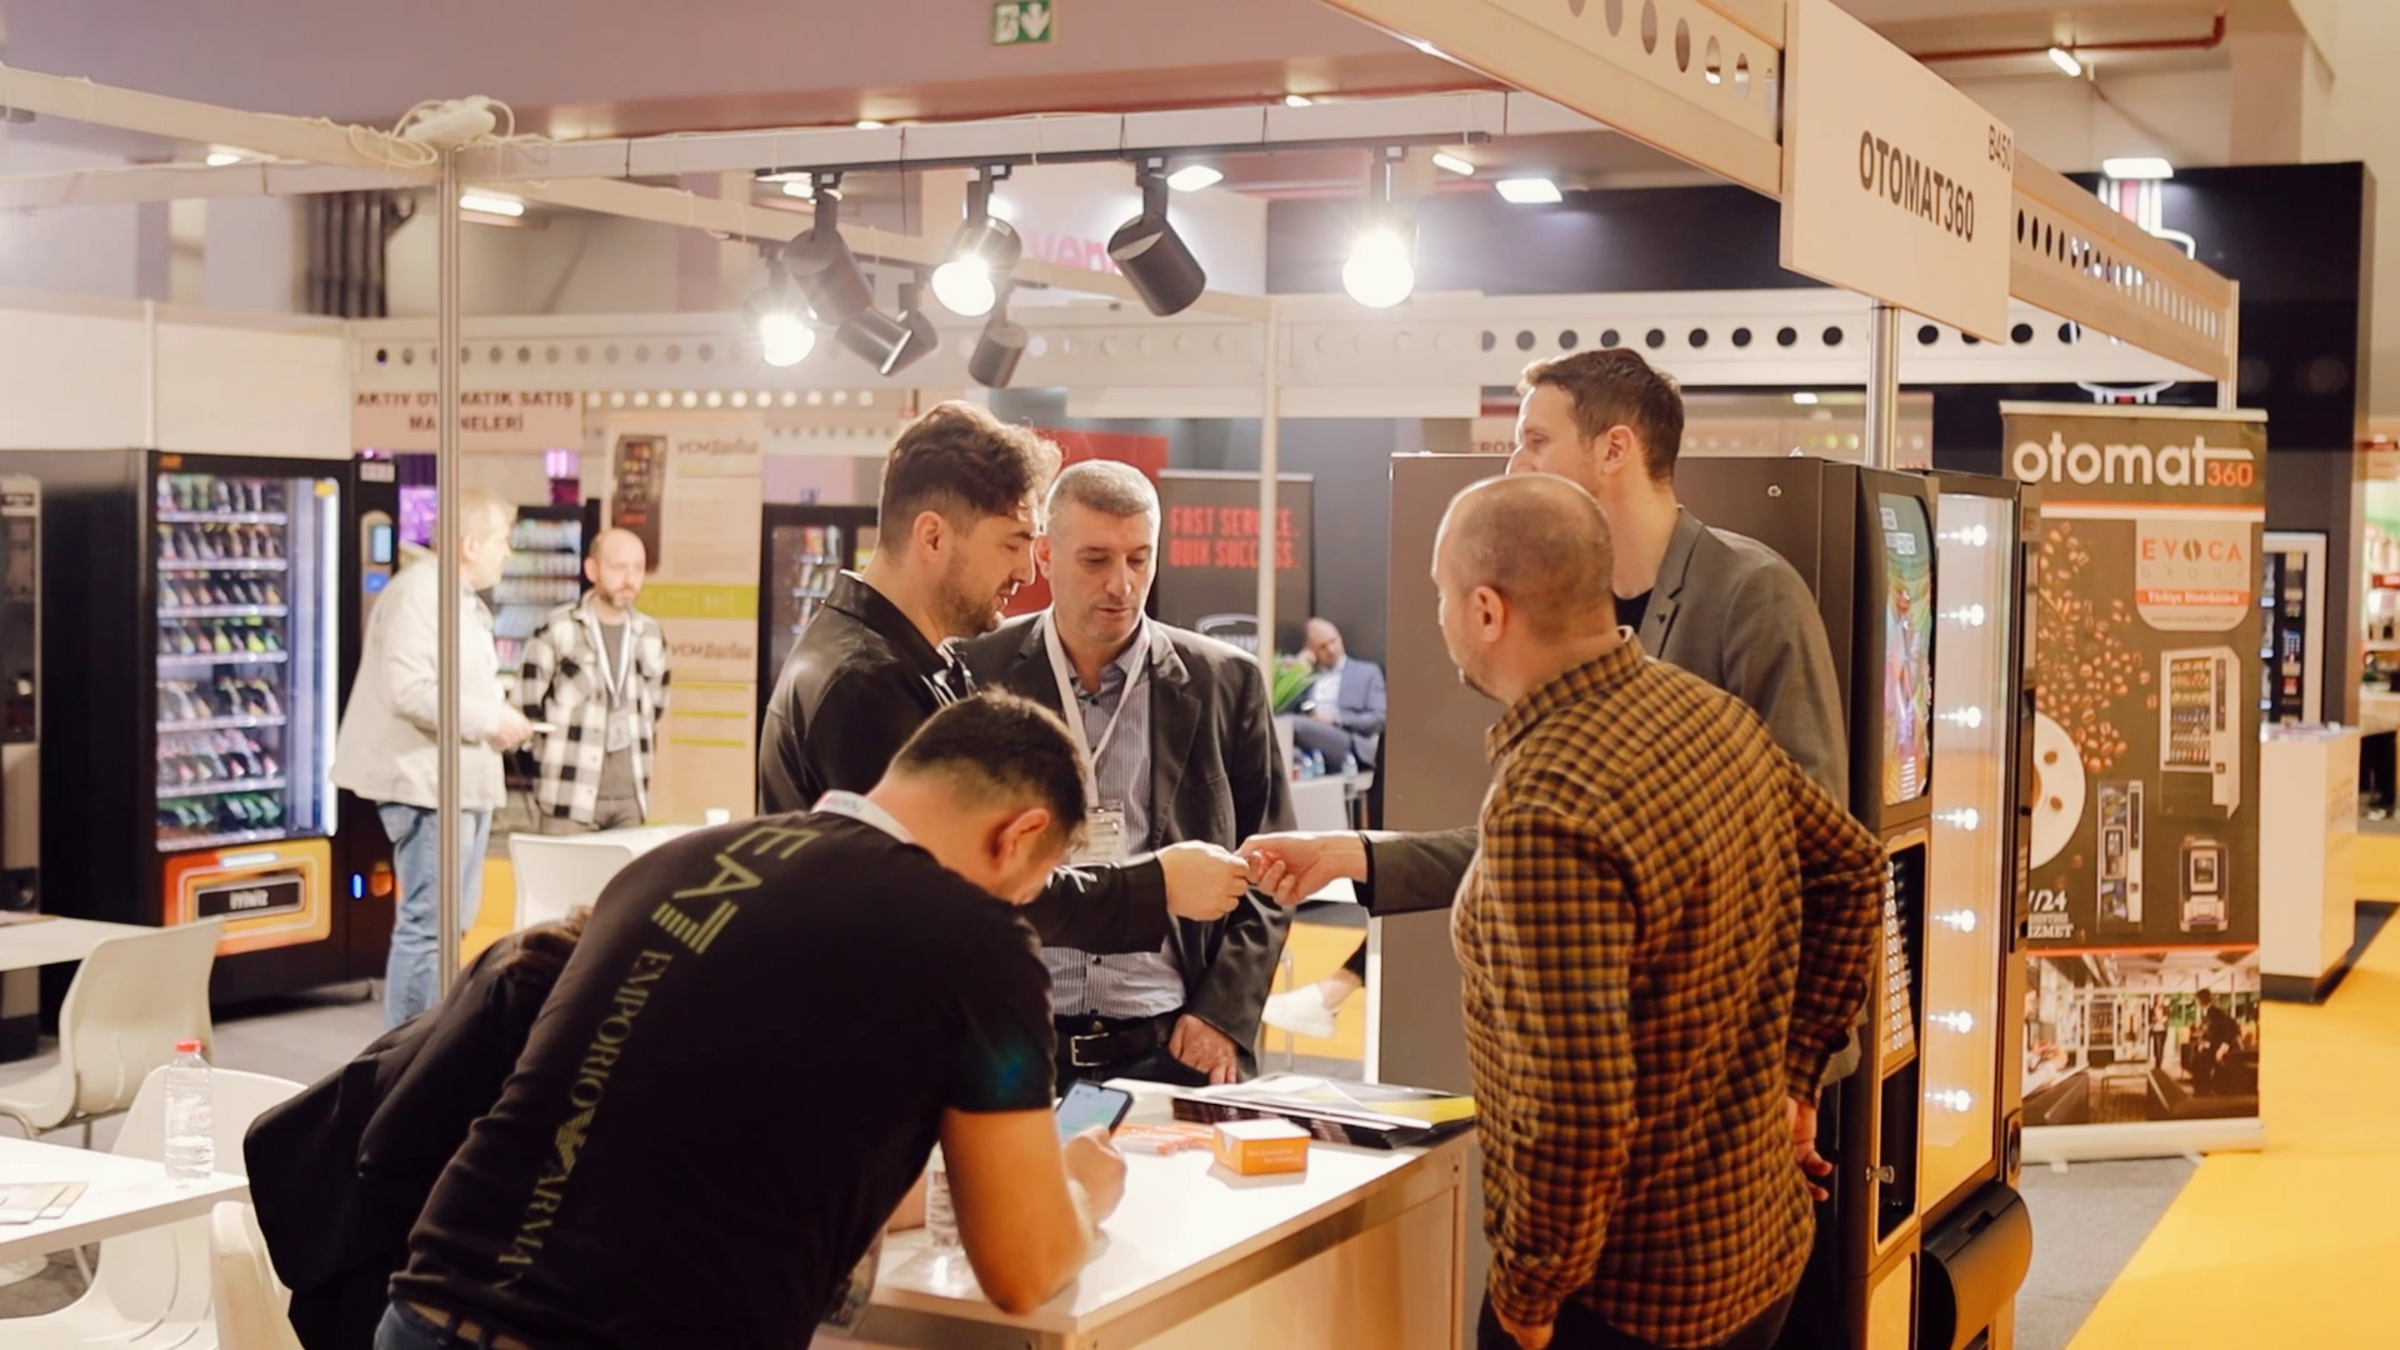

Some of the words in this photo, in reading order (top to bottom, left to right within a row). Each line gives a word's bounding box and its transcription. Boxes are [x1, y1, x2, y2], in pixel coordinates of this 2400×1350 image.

[1859, 130, 1975, 243] OTOMAT360
[1989, 123, 2012, 172] B450
[1169, 505, 1215, 535] FAST
[2141, 539, 2244, 562] EVOCA
[651, 825, 821, 954] EA7
[571, 948, 675, 1109] EMPORIO
[494, 1162, 569, 1293] ARMAN
